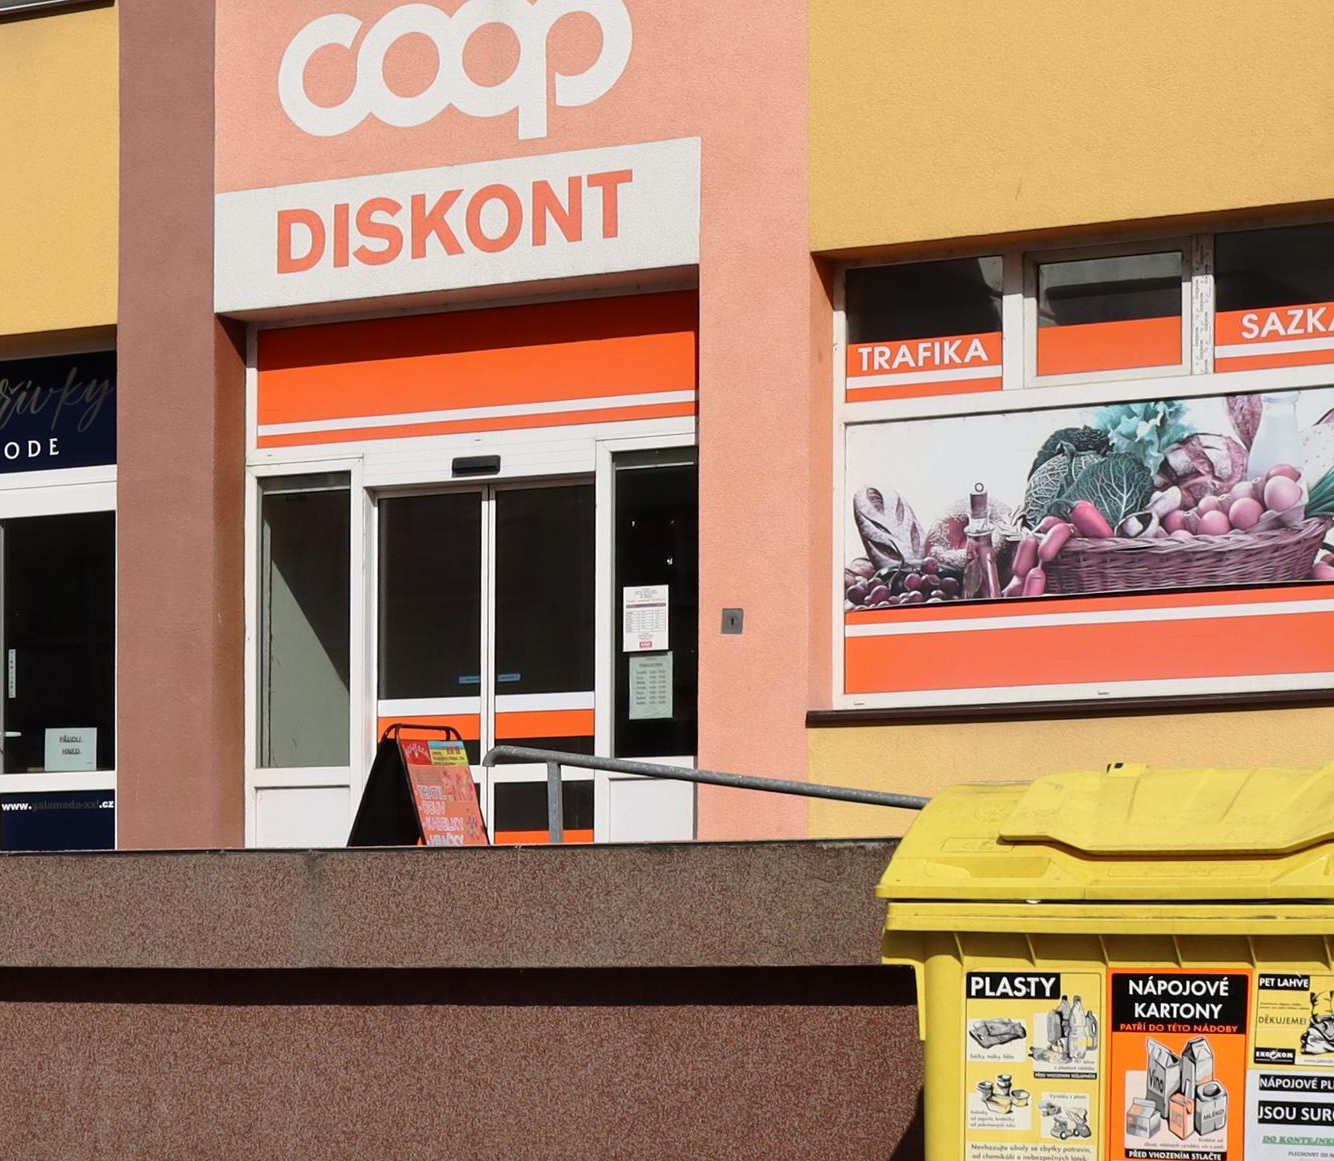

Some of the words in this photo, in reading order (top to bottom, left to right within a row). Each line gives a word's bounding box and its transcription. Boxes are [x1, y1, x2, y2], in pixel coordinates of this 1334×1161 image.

[276, 169, 633, 274] DISKONT
[858, 337, 989, 372] TRAFIKA
[970, 976, 1056, 997] PLASTY
[1129, 976, 1229, 996] NÁPOJOVÉ
[1259, 977, 1275, 987] PET
[1277, 978, 1309, 988] LAHVE
[1134, 1002, 1223, 1019] KARTONY
[1258, 1014, 1307, 1025] DĚKUJEME!
[1120, 1022, 1147, 1031] PATŘÍ
[1167, 1022, 1191, 1032] TÉTO
[1193, 1023, 1238, 1033] NÁDOBY
[1260, 1076, 1317, 1089] NÁPOJOVÉ
[1258, 1106, 1297, 1120] JSOU
[1262, 1135, 1277, 1144] DO
[1129, 1150, 1147, 1158] PŘED
[1148, 1151, 1190, 1160] VHOZENÍM
[1192, 1152, 1221, 1160] STLAČTE
